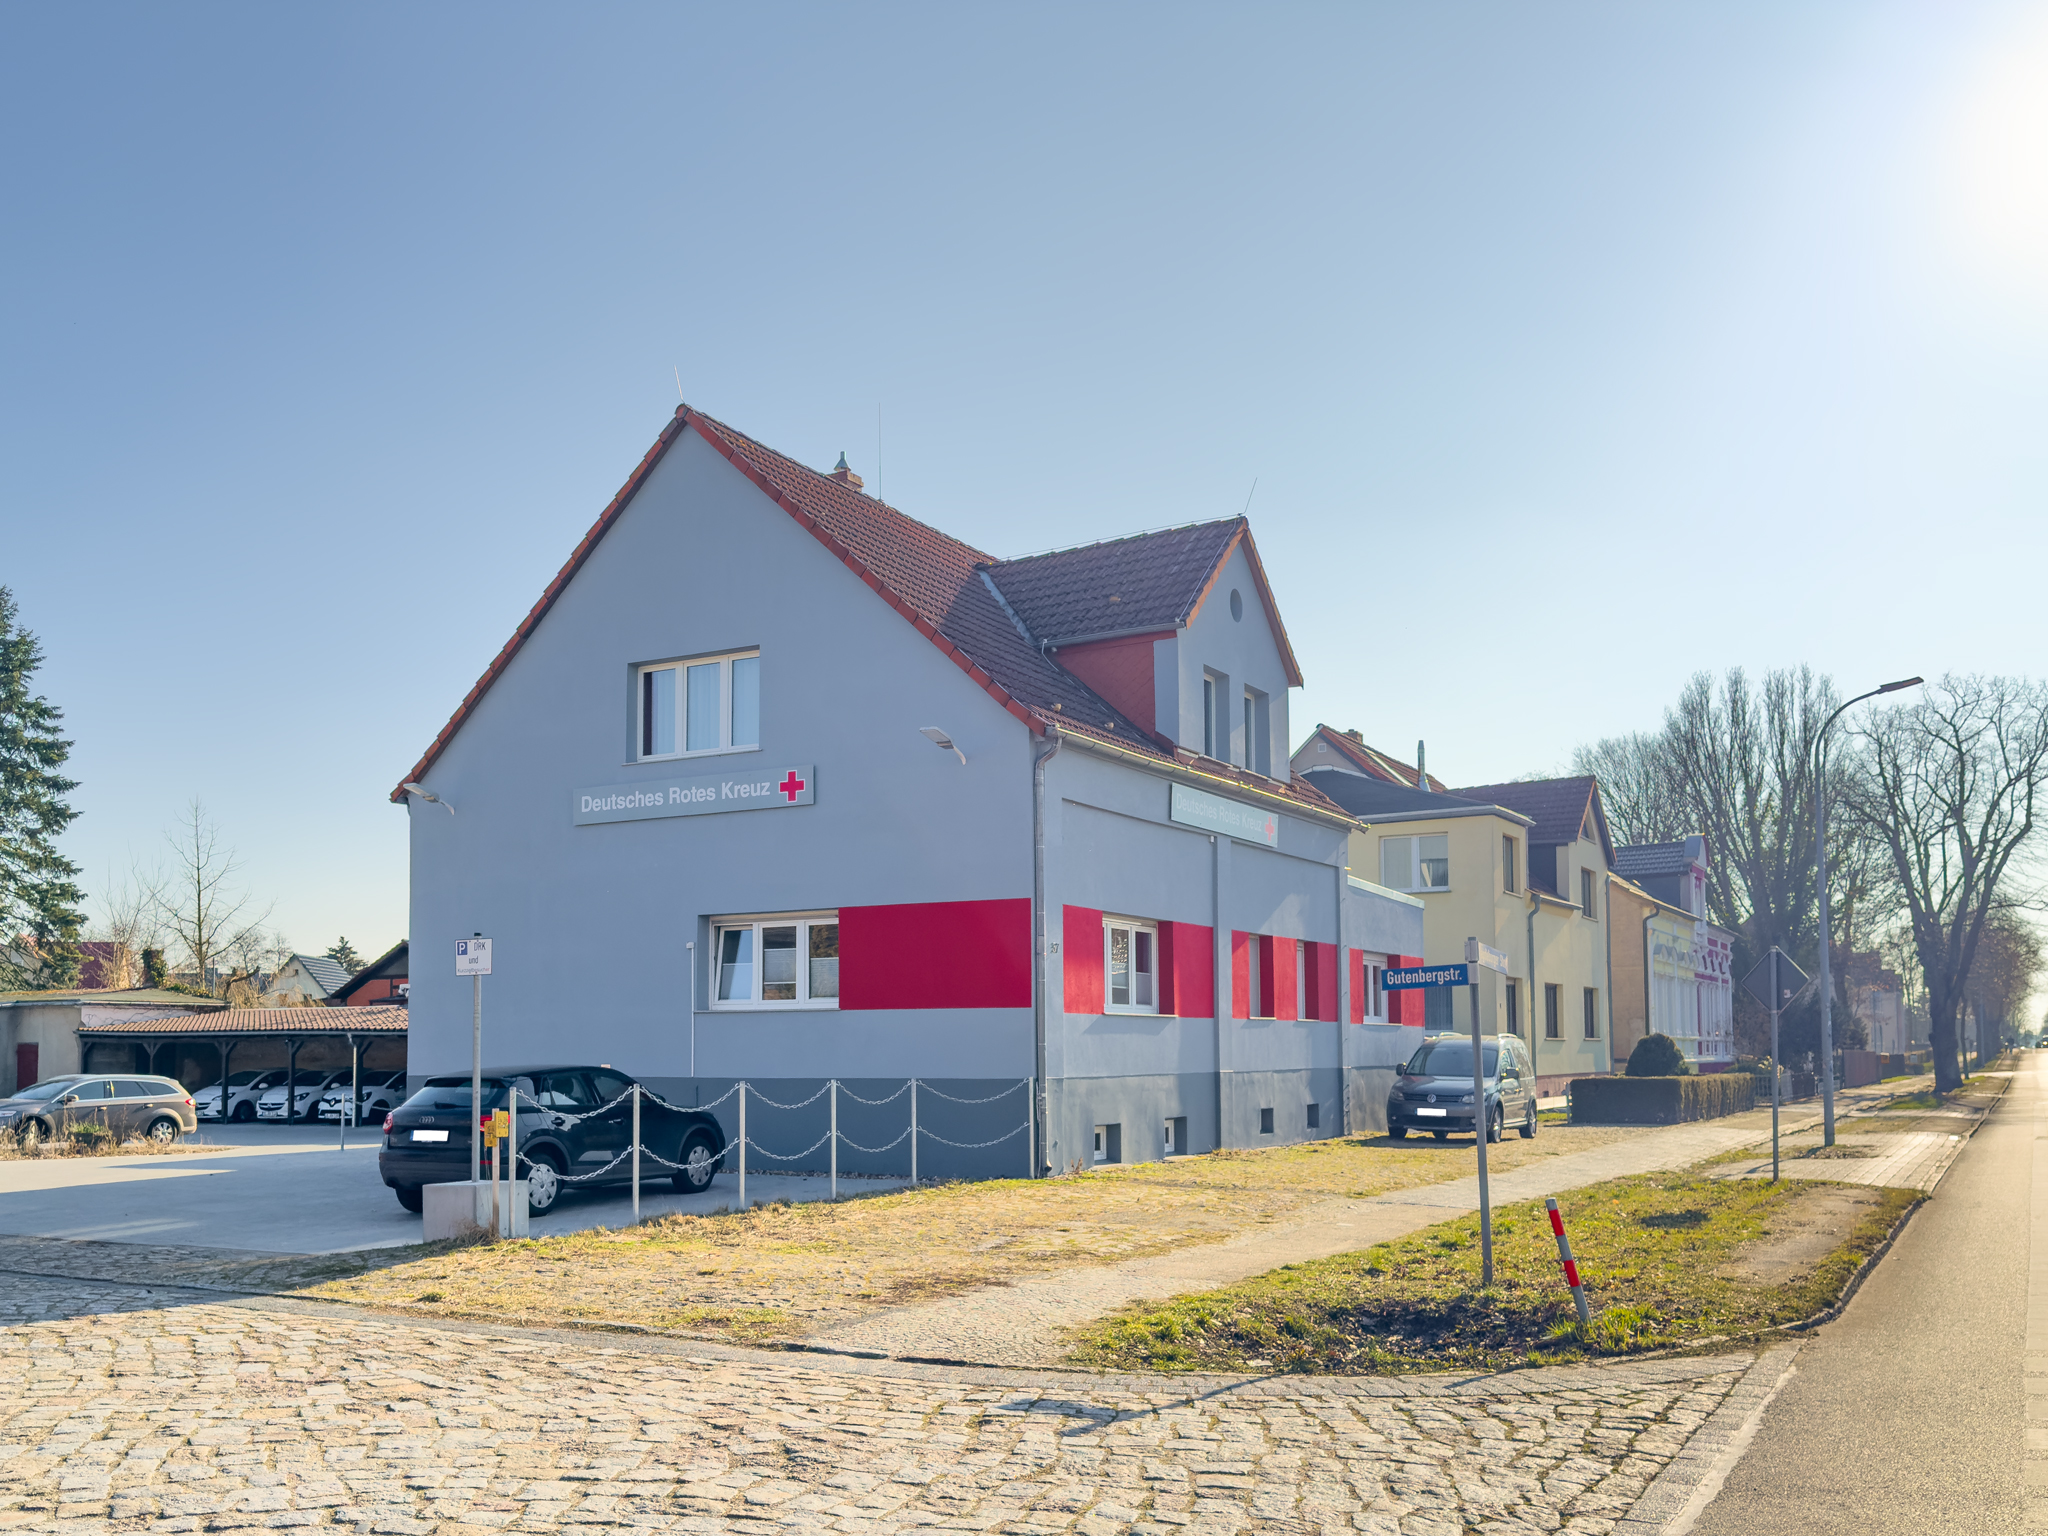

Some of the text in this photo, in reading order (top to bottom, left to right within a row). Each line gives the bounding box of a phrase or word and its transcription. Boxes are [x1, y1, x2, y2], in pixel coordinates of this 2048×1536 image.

[581, 781, 771, 813] Deutsches Rotes Kreuz
[1176, 792, 1262, 832] Deutsches Rotes Kreuz
[459, 942, 466, 955] P
[474, 941, 486, 951] DRK
[469, 956, 478, 964] und
[1387, 968, 1462, 985] Gutenbergstr.
